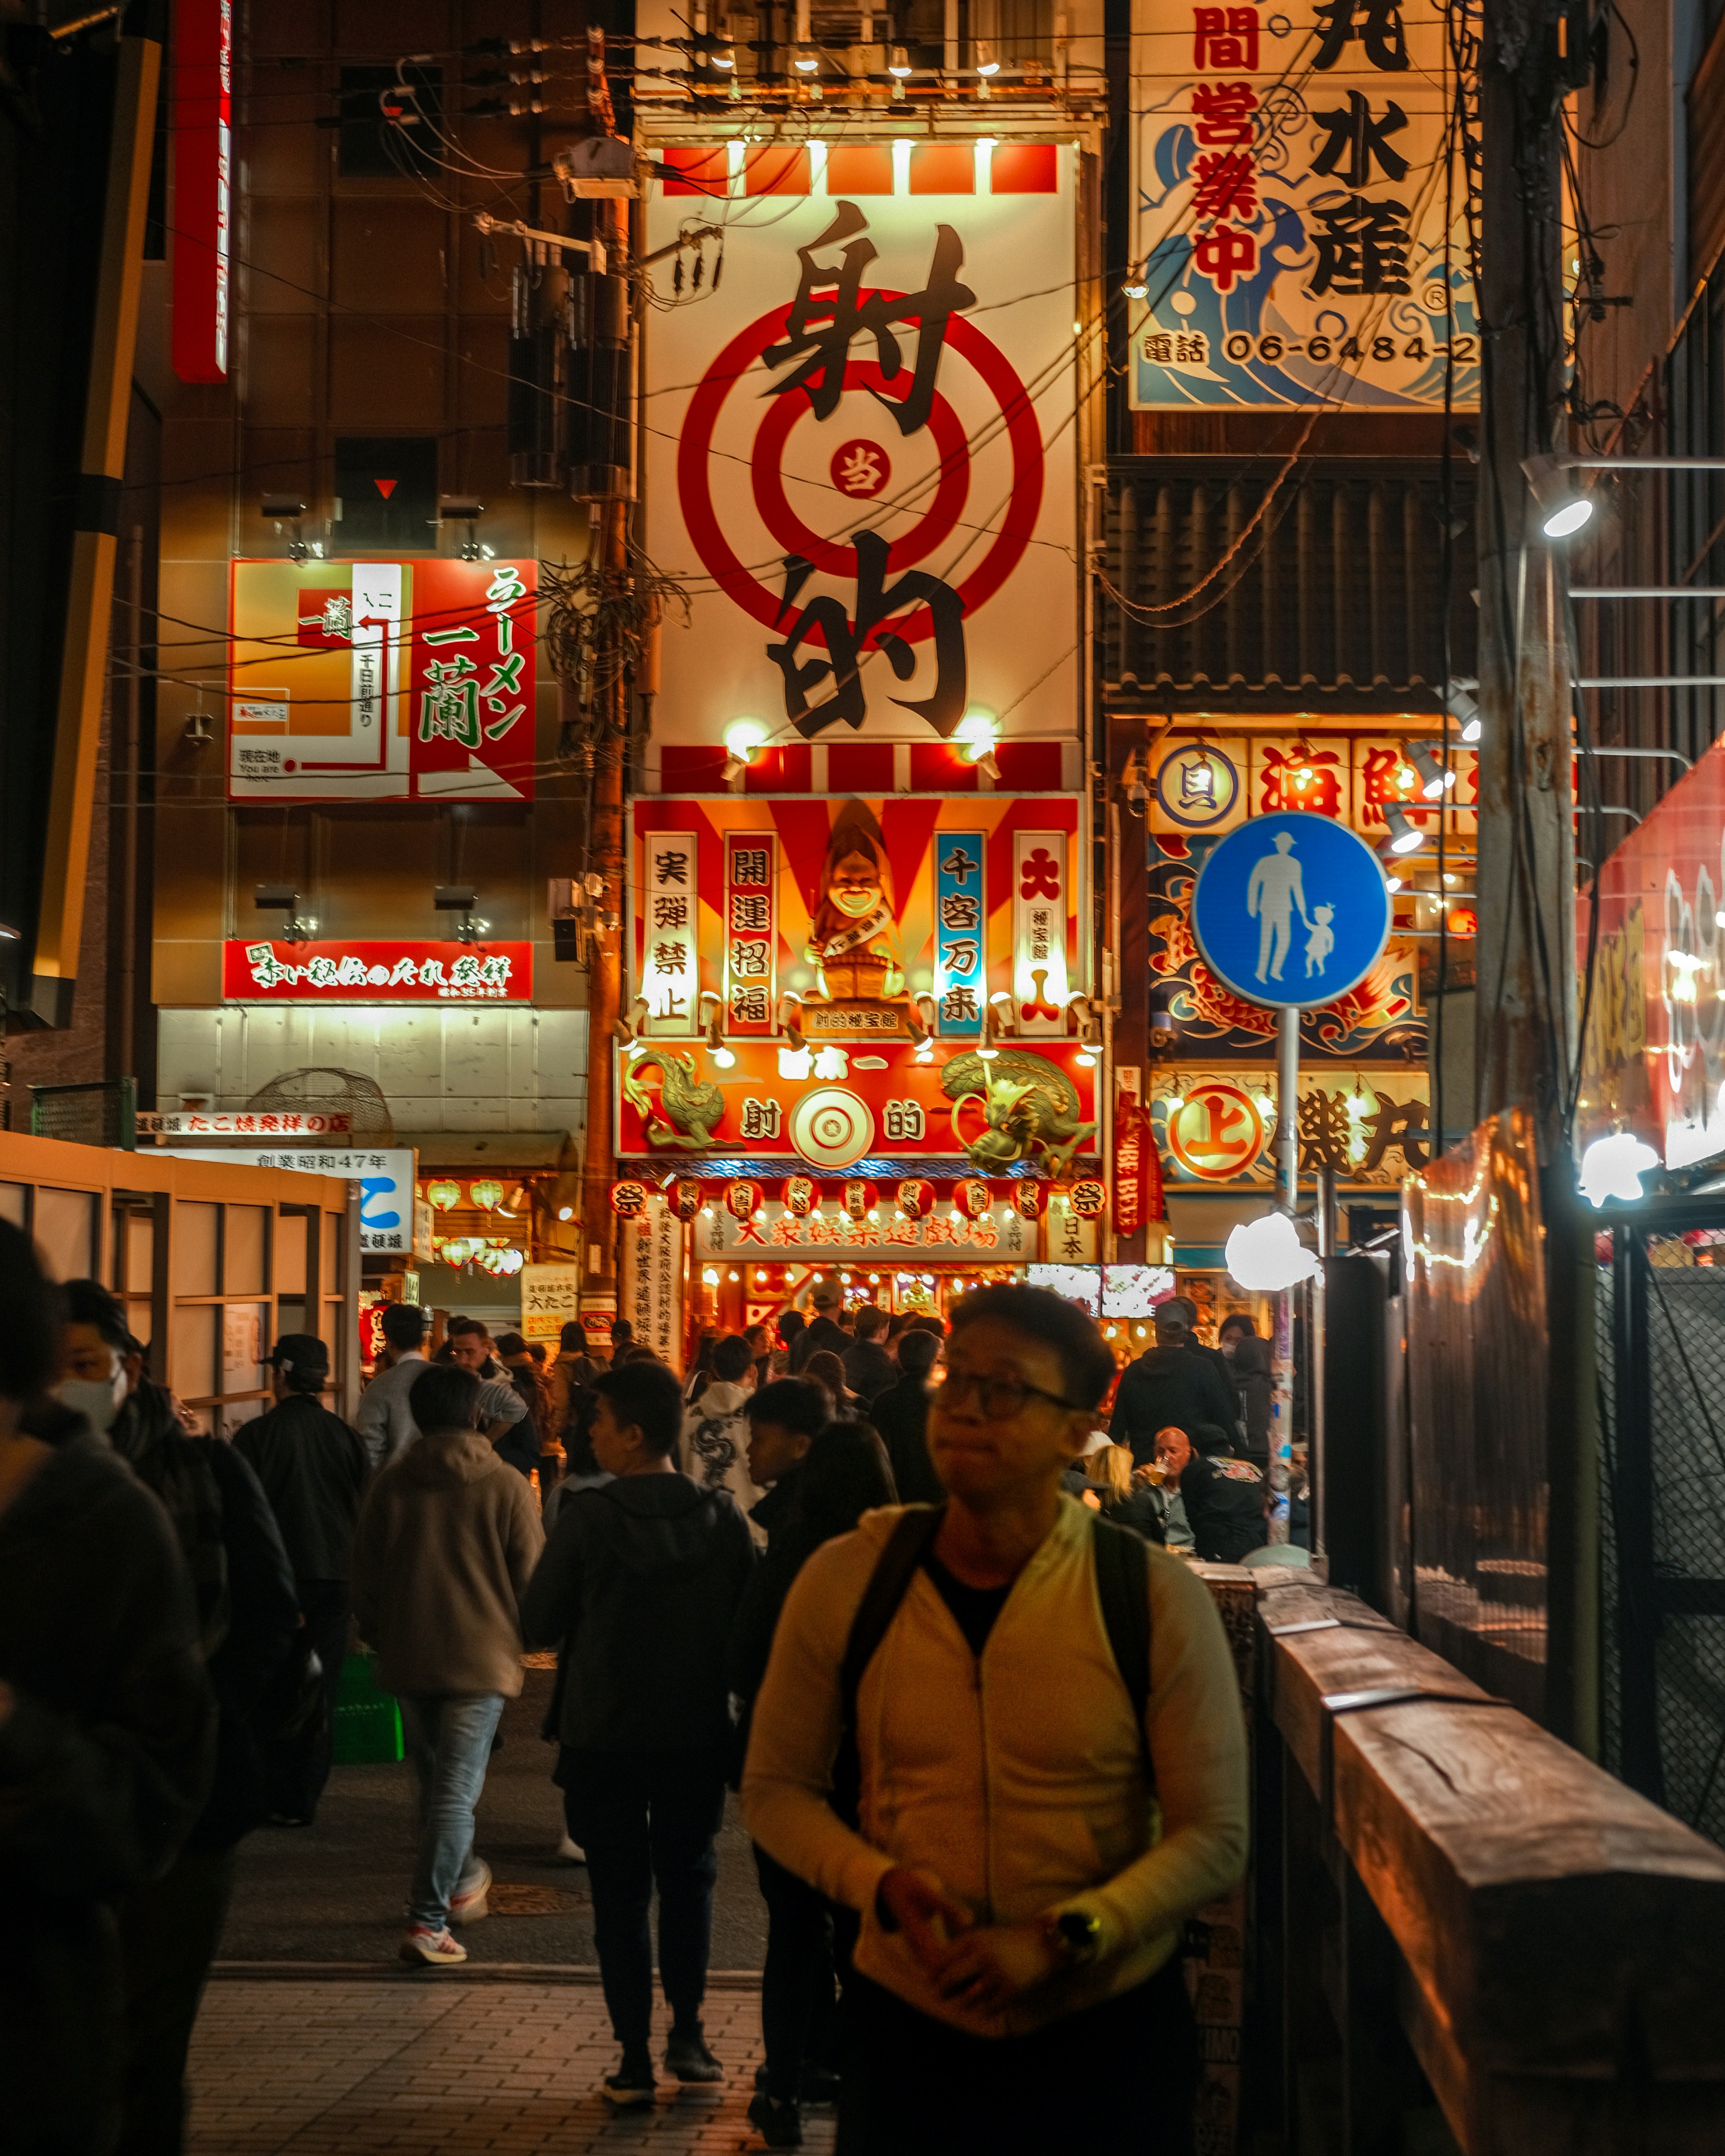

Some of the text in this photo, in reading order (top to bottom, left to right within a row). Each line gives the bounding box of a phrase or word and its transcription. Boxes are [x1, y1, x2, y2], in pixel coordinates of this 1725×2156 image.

[1143, 333, 1208, 363] 電話
[758, 198, 977, 739] 射的
[839, 447, 882, 492] 当
[298, 595, 353, 640] 一蘭
[480, 567, 527, 741] ラーメン
[360, 654, 375, 728] 千日前通り
[417, 626, 483, 750] 一蘭
[238, 764, 280, 774] You are
[239, 750, 281, 763] 現在地
[654, 850, 690, 1021] 実弾禁止
[731, 848, 771, 1022] 開運招福
[940, 847, 979, 1022] 千客万来
[741, 1097, 925, 1139] 射 的
[258, 1154, 386, 1169] 創業昭和47年
